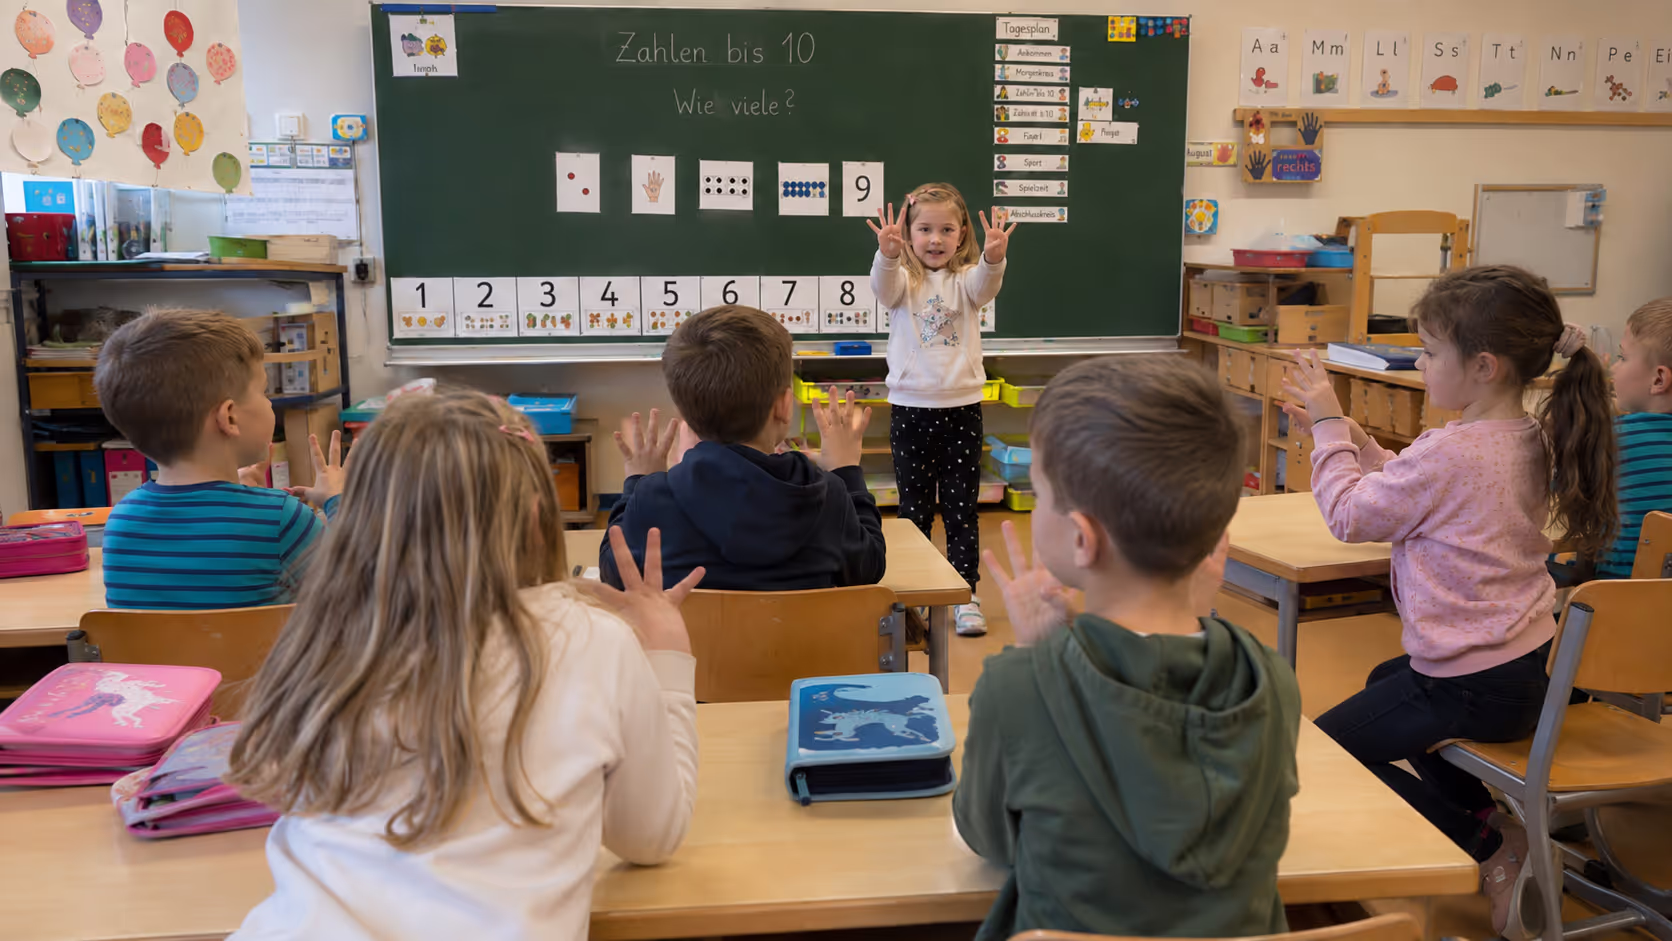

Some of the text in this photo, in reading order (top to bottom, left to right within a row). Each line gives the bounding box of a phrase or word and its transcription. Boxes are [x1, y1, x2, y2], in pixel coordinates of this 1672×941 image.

[1002, 22, 1050, 38] Tagesplan
[615, 31, 817, 64] Zahlen bis 10
[673, 87, 716, 115] Wie
[1024, 157, 1043, 170] Sport
[1277, 159, 1317, 173] rechts
[854, 174, 871, 203] 9
[415, 281, 426, 309] 1
[476, 281, 494, 309] 2
[539, 280, 557, 308] 3
[600, 280, 619, 308] 4
[662, 280, 681, 308] 5
[721, 279, 743, 306] 6
[781, 279, 798, 307] 7
[839, 279, 856, 307] 8
